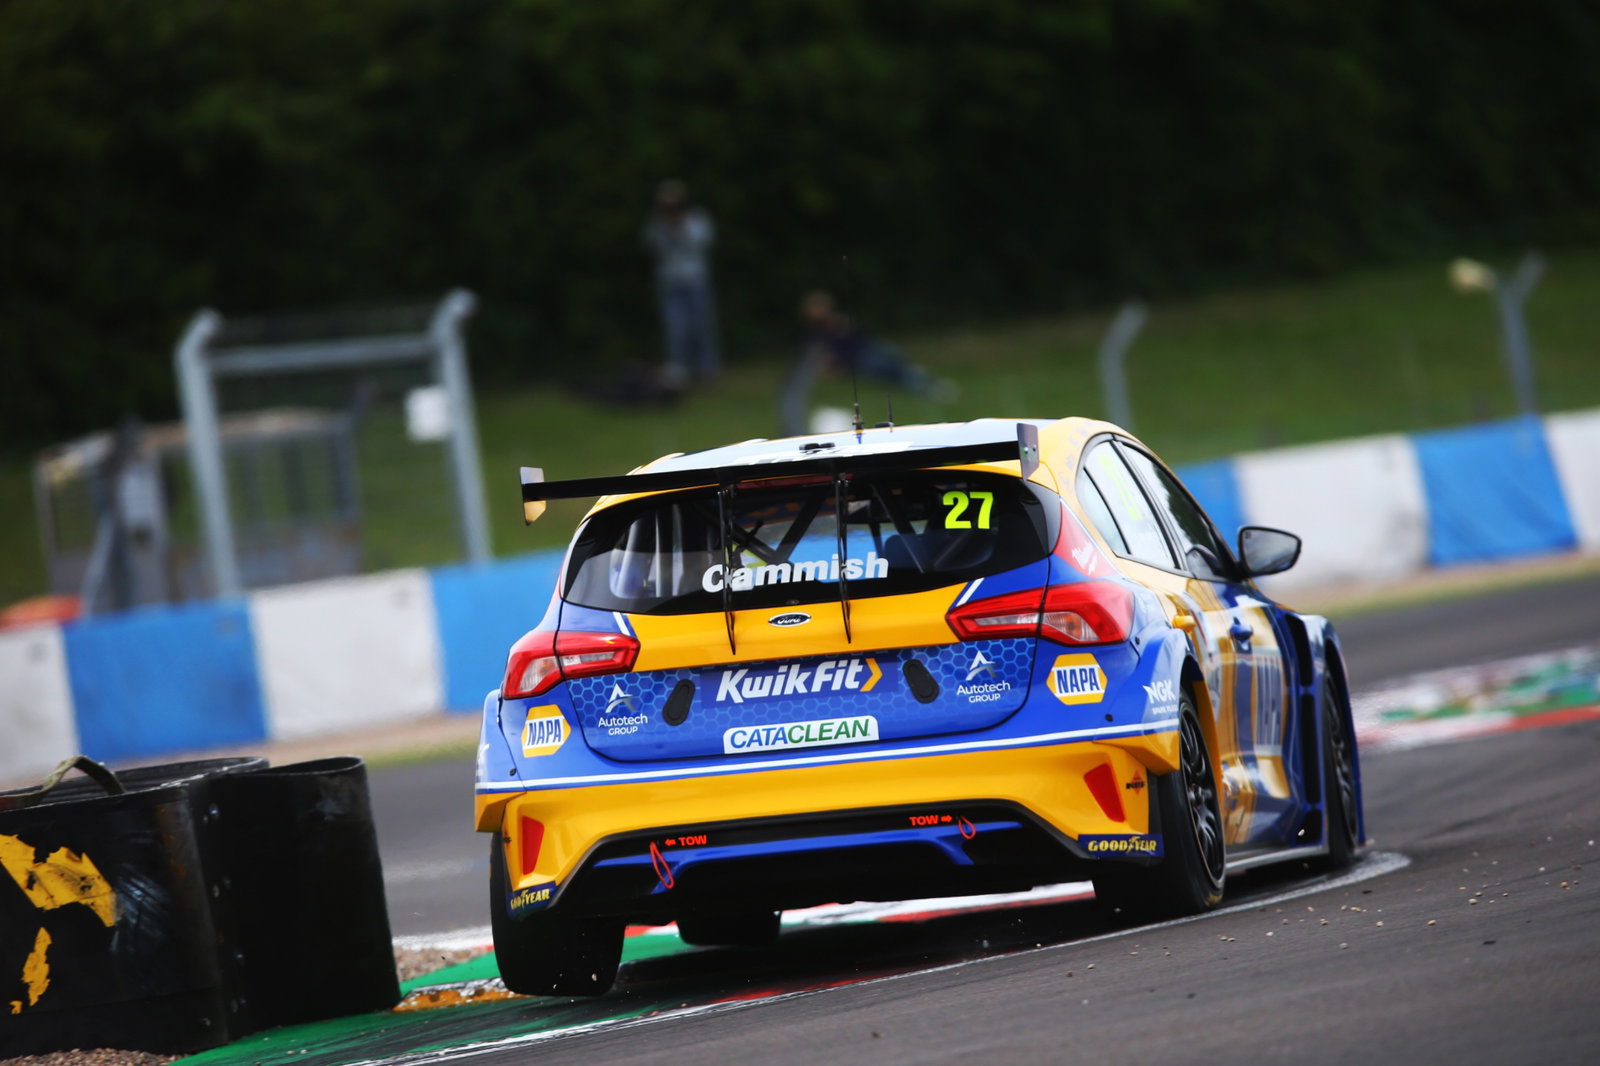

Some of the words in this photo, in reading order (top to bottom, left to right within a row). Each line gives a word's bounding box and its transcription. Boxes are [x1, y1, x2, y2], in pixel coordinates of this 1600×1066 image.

[942, 491, 994, 530] 27
[702, 551, 889, 593] Cammish
[956, 679, 1011, 696] Autotech
[1056, 667, 1101, 694] NAPA
[968, 693, 1001, 703] GROUP
[1142, 679, 1176, 704] NGK
[597, 713, 648, 728] Autotech
[527, 718, 563, 744] NAPA
[608, 725, 638, 736] GROUP
[730, 718, 870, 749] CATACLEAN
[909, 814, 938, 826] TOW
[678, 835, 707, 847] TOW
[1087, 835, 1157, 854] GOODYEAR
